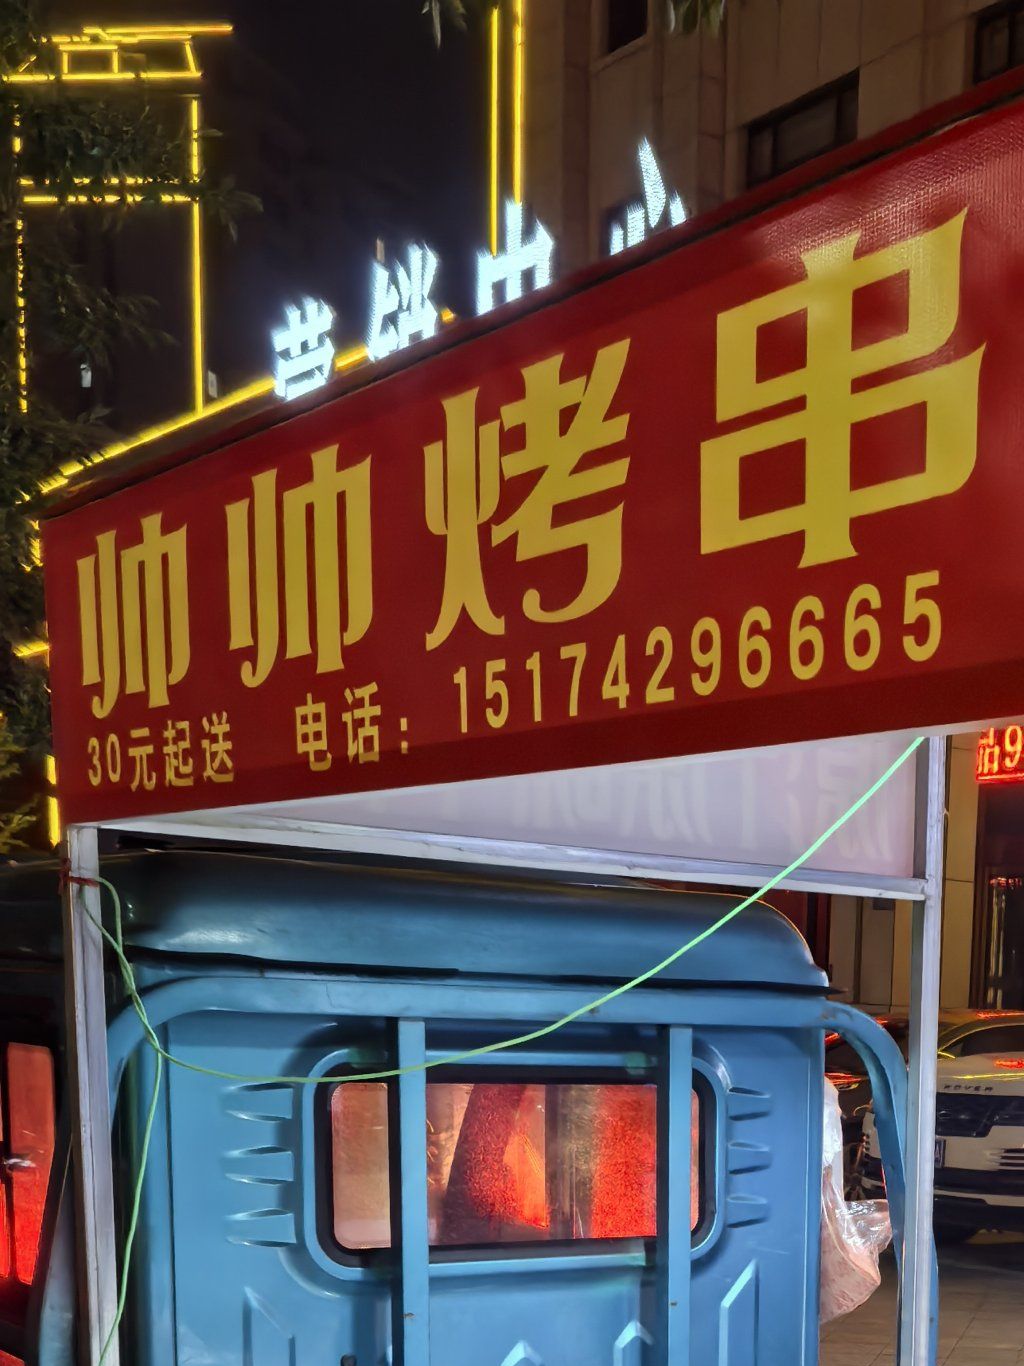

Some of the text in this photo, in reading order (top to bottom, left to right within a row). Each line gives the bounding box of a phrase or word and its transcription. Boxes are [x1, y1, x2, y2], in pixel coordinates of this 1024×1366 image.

[76, 205, 987, 719] 帅帅烤串
[87, 711, 235, 793] 30元起送
[453, 569, 943, 733] 15174296665
